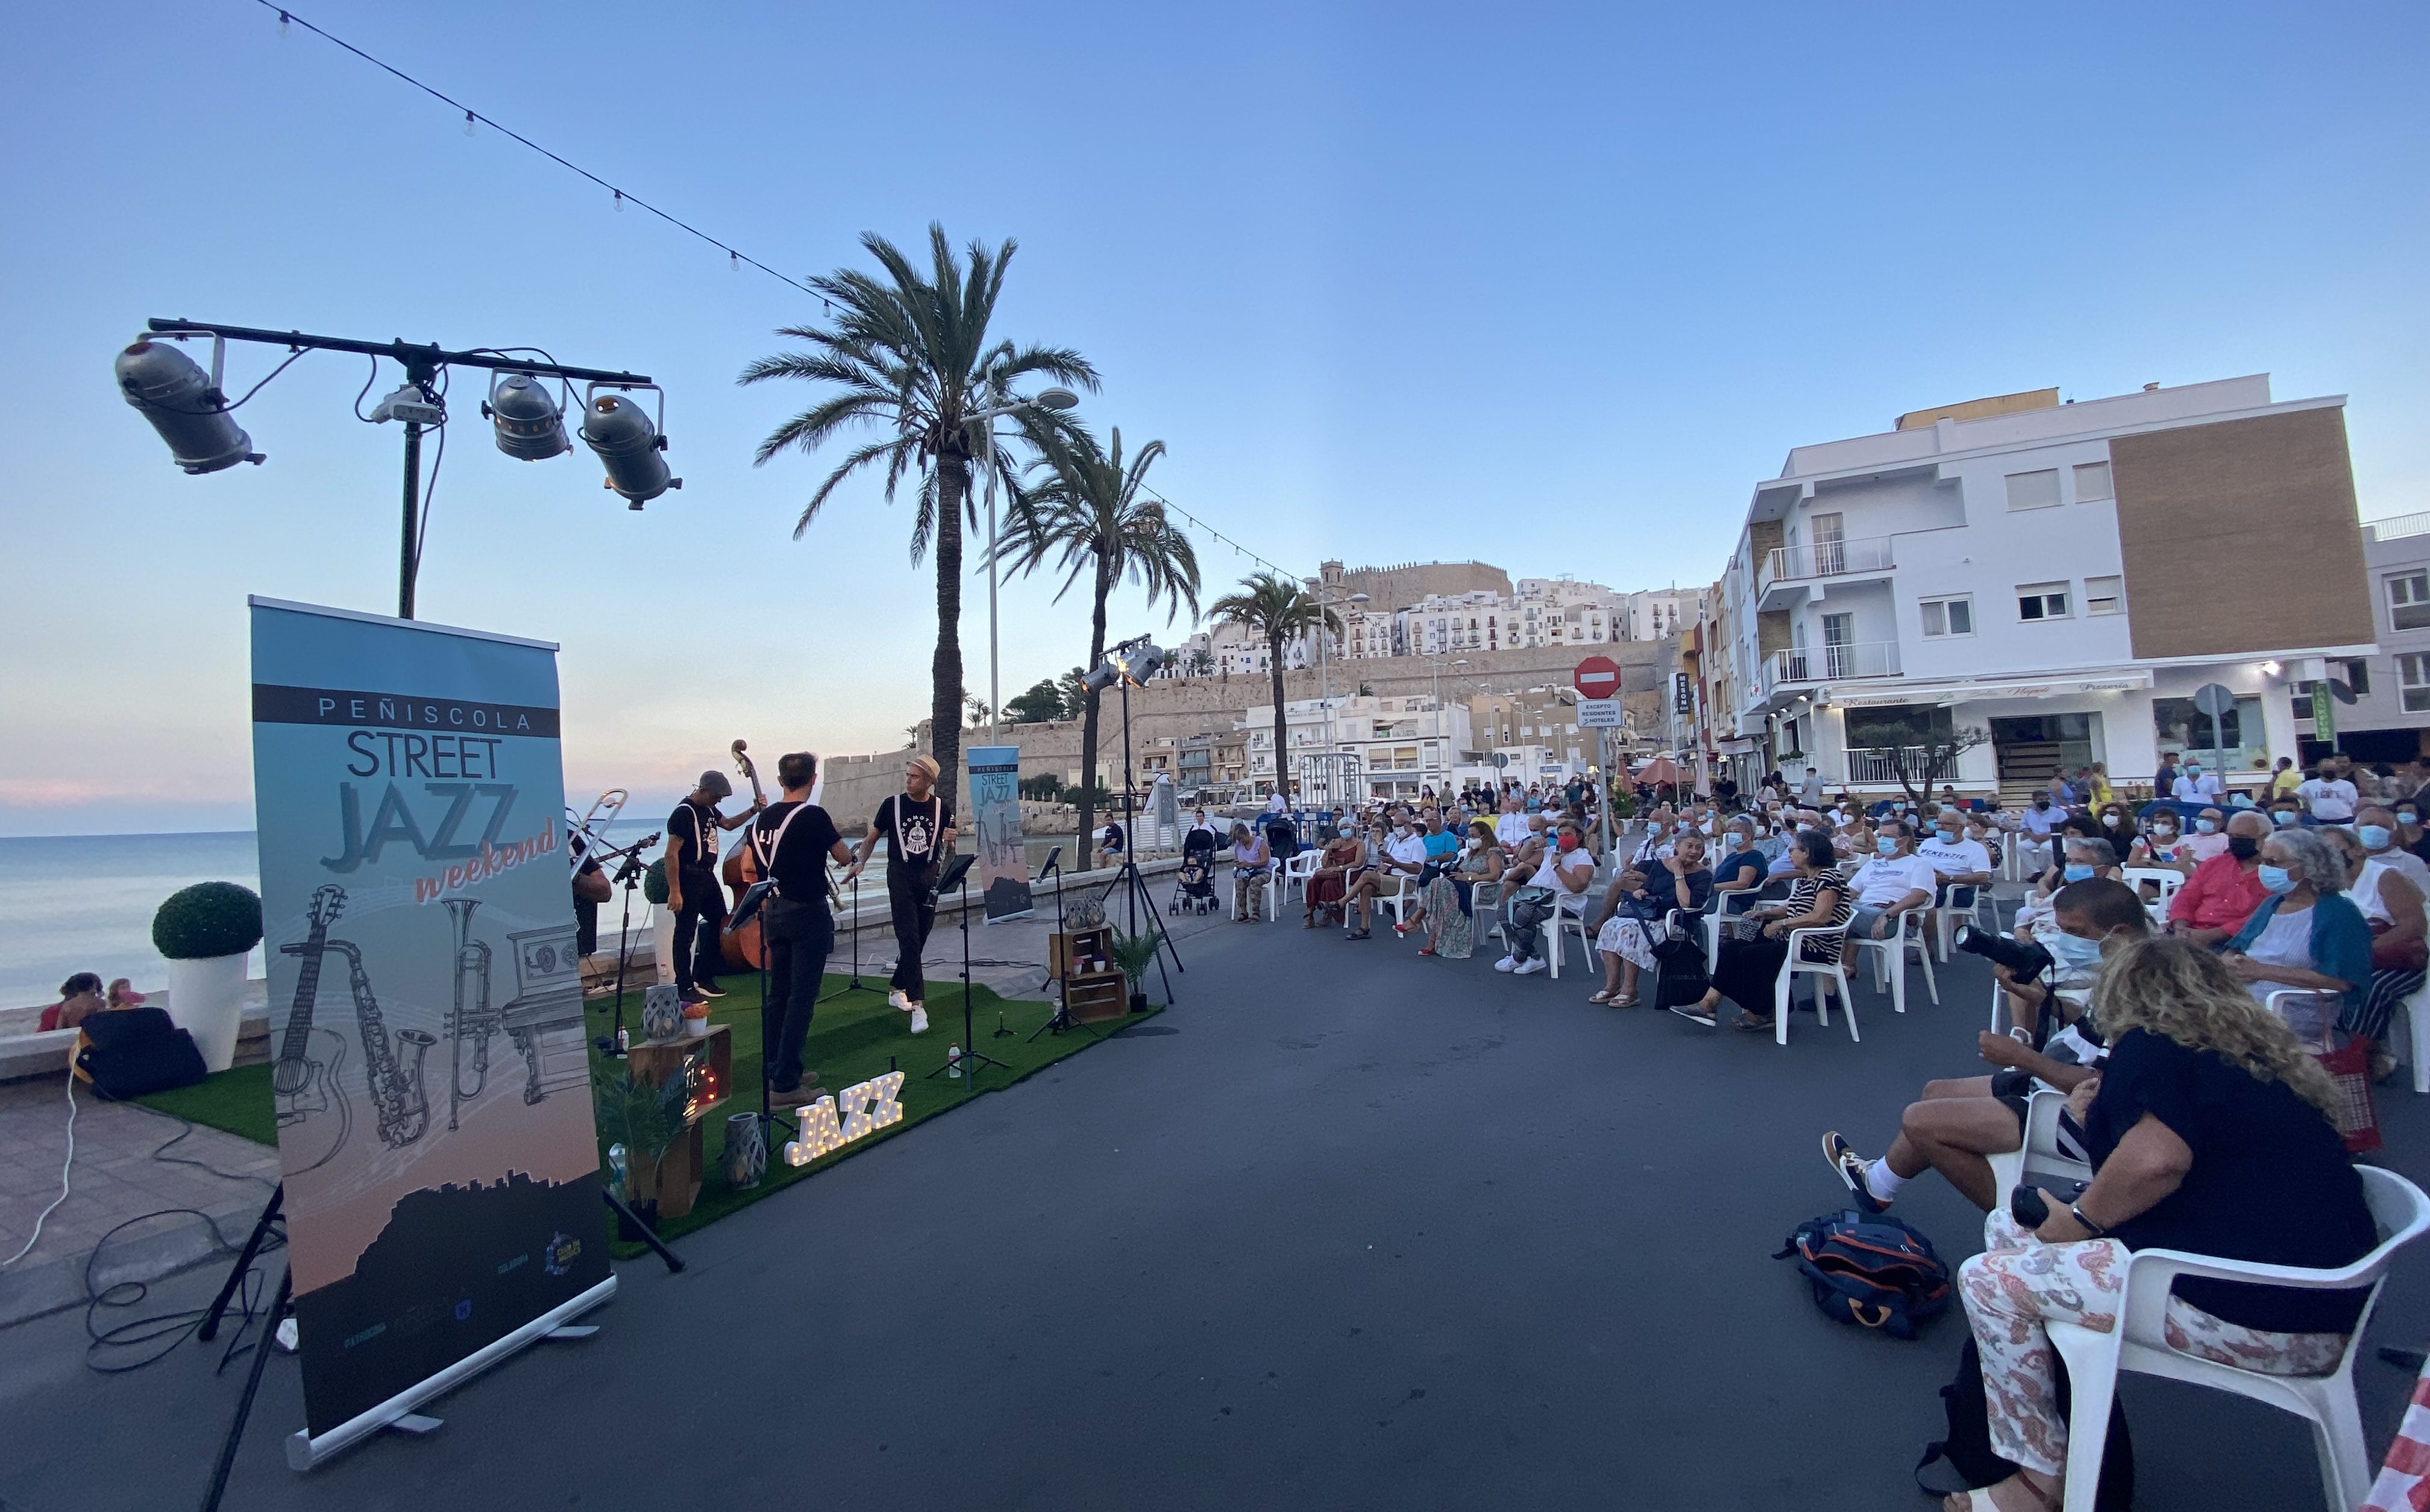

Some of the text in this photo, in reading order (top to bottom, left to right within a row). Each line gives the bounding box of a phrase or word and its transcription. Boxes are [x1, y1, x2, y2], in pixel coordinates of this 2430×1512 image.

[318, 697, 530, 730] PEÑISCOLA
[1844, 697, 1909, 707] Restaurante
[2008, 686, 2051, 695] Napoli
[347, 730, 502, 779] STREET
[979, 785, 1011, 808] JAZZ
[982, 773, 1008, 786] STREET
[319, 779, 520, 874] JAZZ
[415, 816, 560, 905] weekend
[784, 1070, 905, 1167] JAZZ
